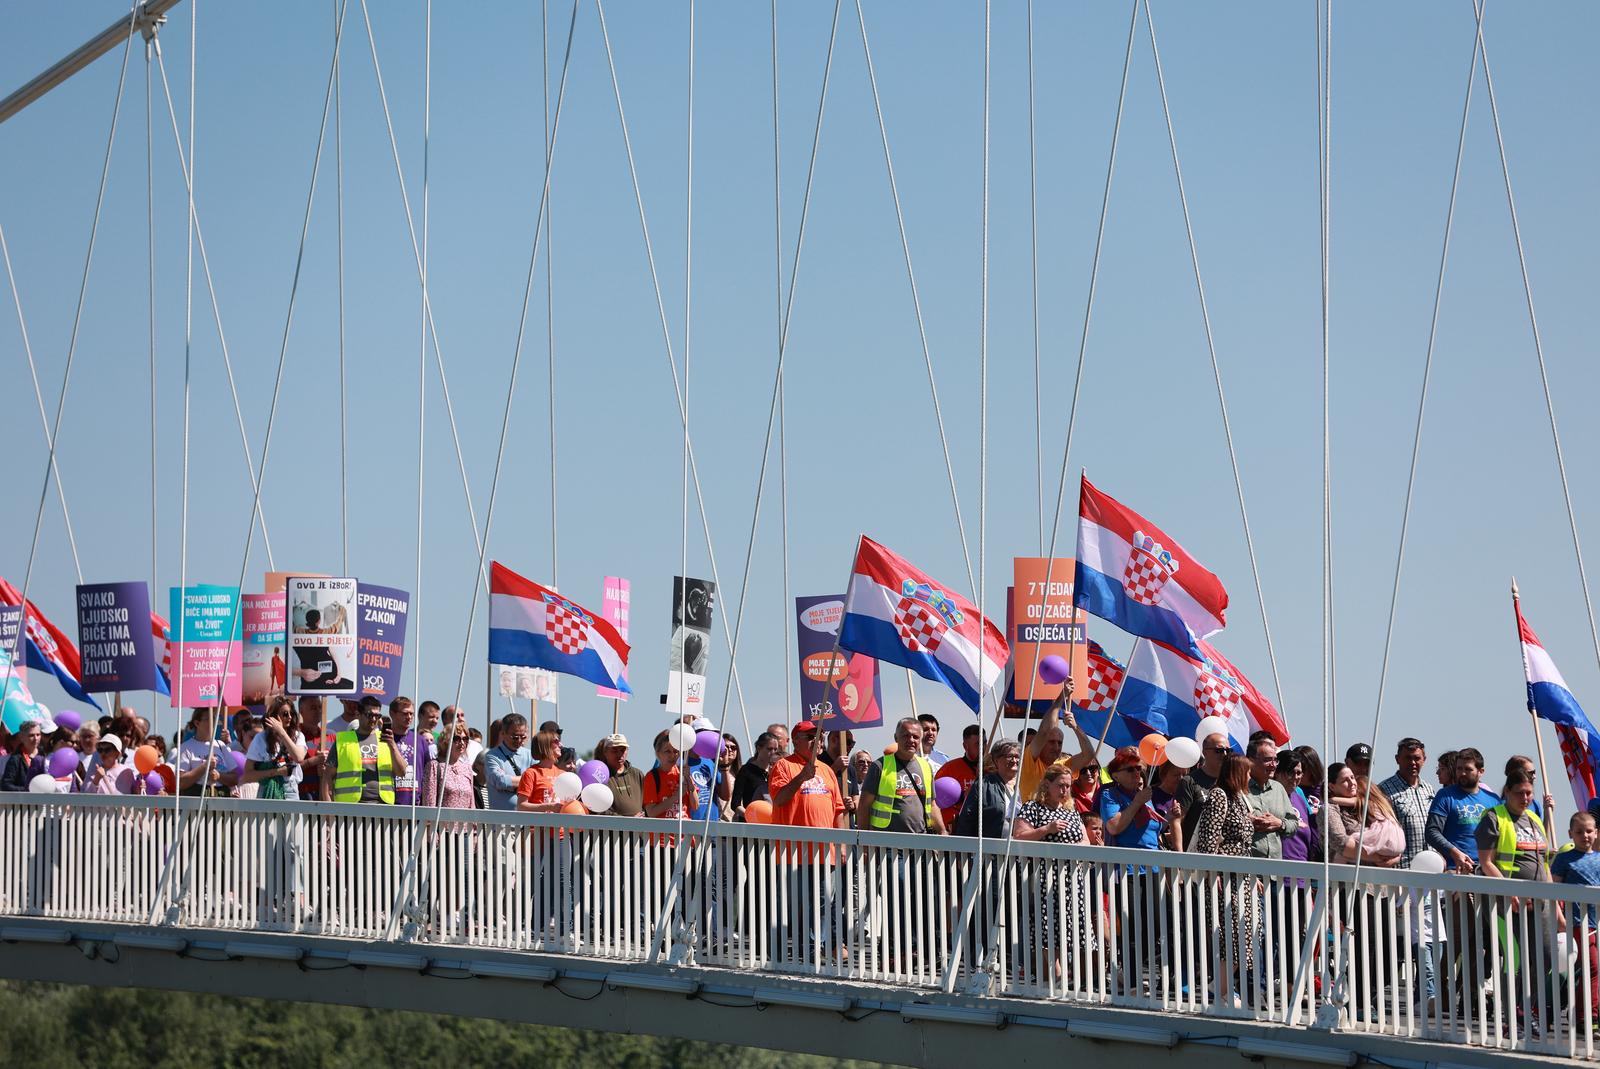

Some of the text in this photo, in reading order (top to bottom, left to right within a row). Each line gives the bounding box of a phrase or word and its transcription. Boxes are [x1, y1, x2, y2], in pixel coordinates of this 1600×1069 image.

[318, 581, 327, 589] JE
[1028, 582, 1036, 596] 7
[81, 591, 115, 608] SVAKO
[358, 593, 407, 614] EPRAVEDAN
[2, 611, 21, 622] ZAKO
[82, 608, 129, 624] LJUDSKO
[364, 609, 396, 626] ZAKON
[1027, 601, 1081, 618] OD ZAČEA
[108, 624, 130, 640] IMA
[294, 637, 312, 645] OVO
[315, 637, 324, 645] JE
[359, 637, 402, 657] PRAVEDNA
[83, 641, 136, 658] PRAVO NA
[363, 653, 390, 669] DJELA
[808, 659, 825, 667] MOJE
[808, 667, 841, 676] MOJ IZOR
